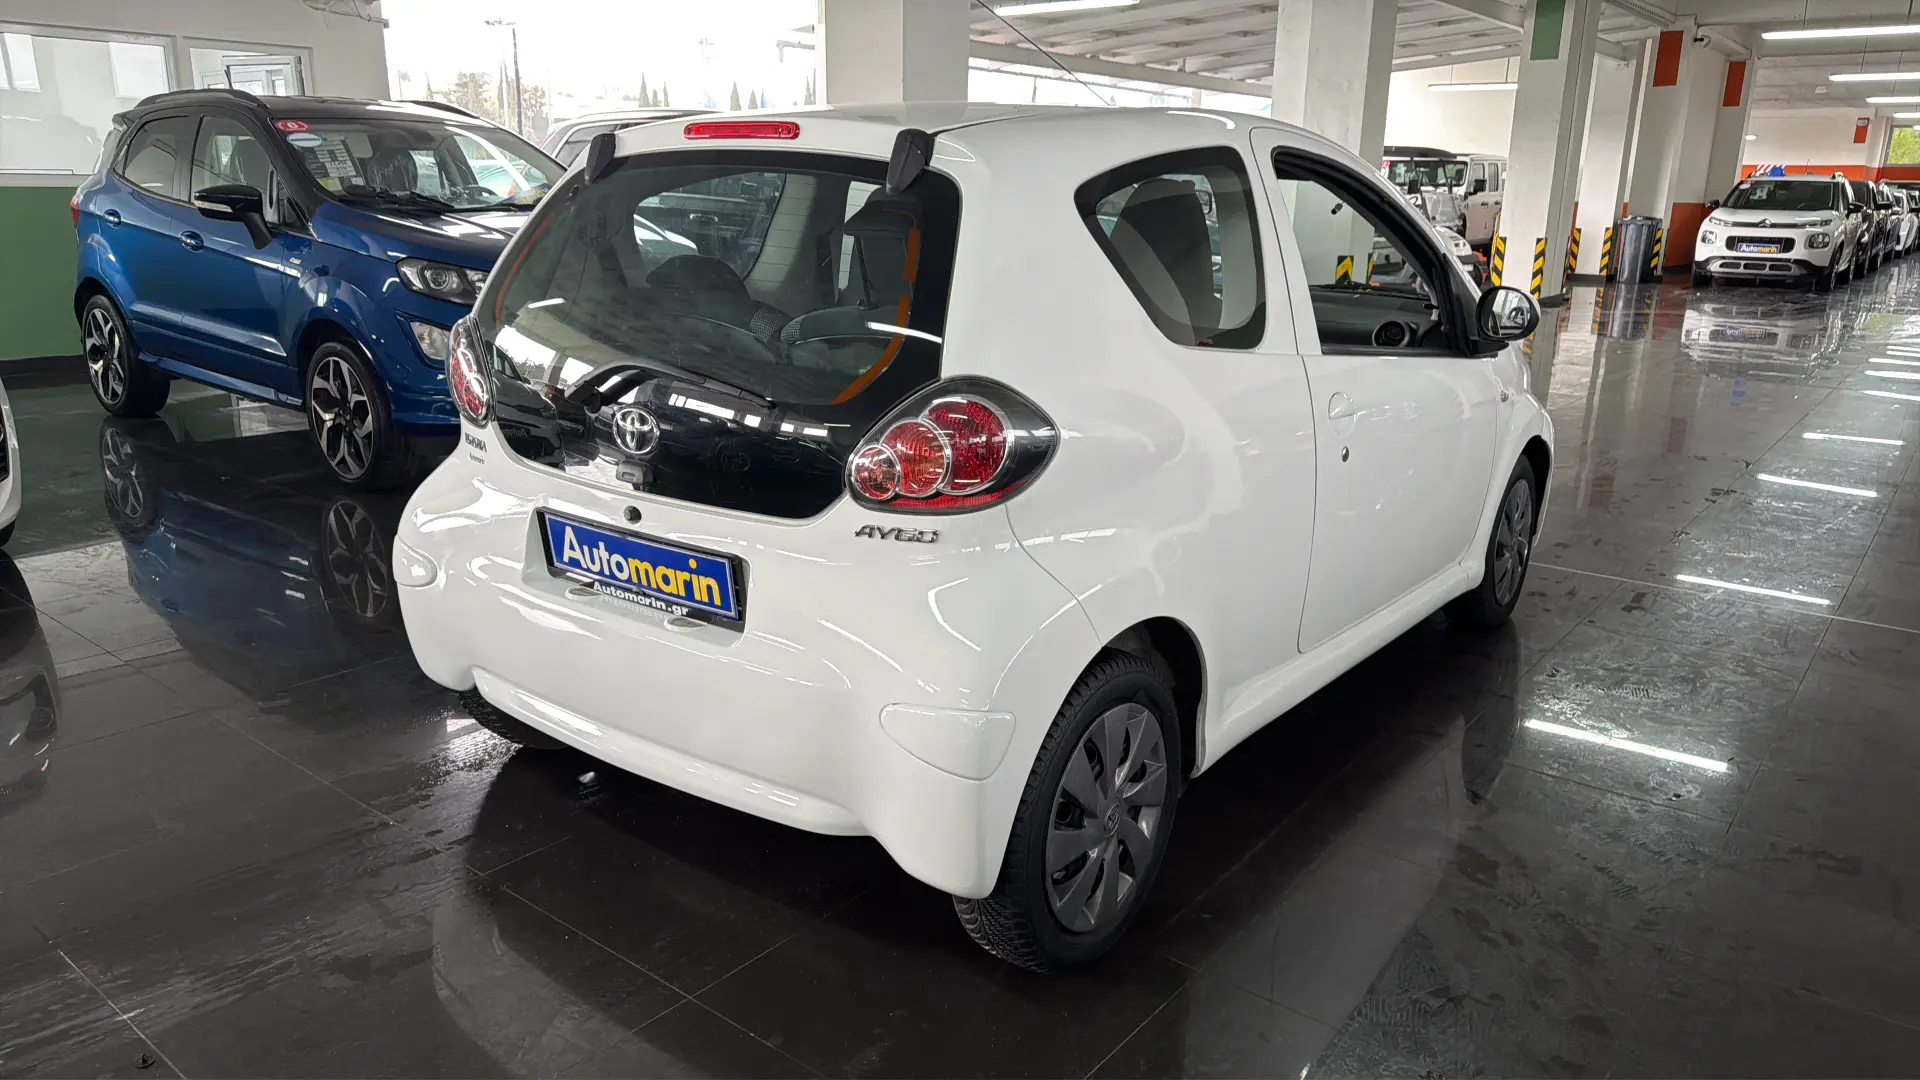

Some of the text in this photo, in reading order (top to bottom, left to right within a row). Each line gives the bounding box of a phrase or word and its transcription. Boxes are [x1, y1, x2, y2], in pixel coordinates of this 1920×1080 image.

[1740, 243, 1777, 253] Automarin
[853, 524, 940, 543] AYGO
[562, 525, 722, 606] Automarin
[592, 580, 690, 616] Automarin.gr
